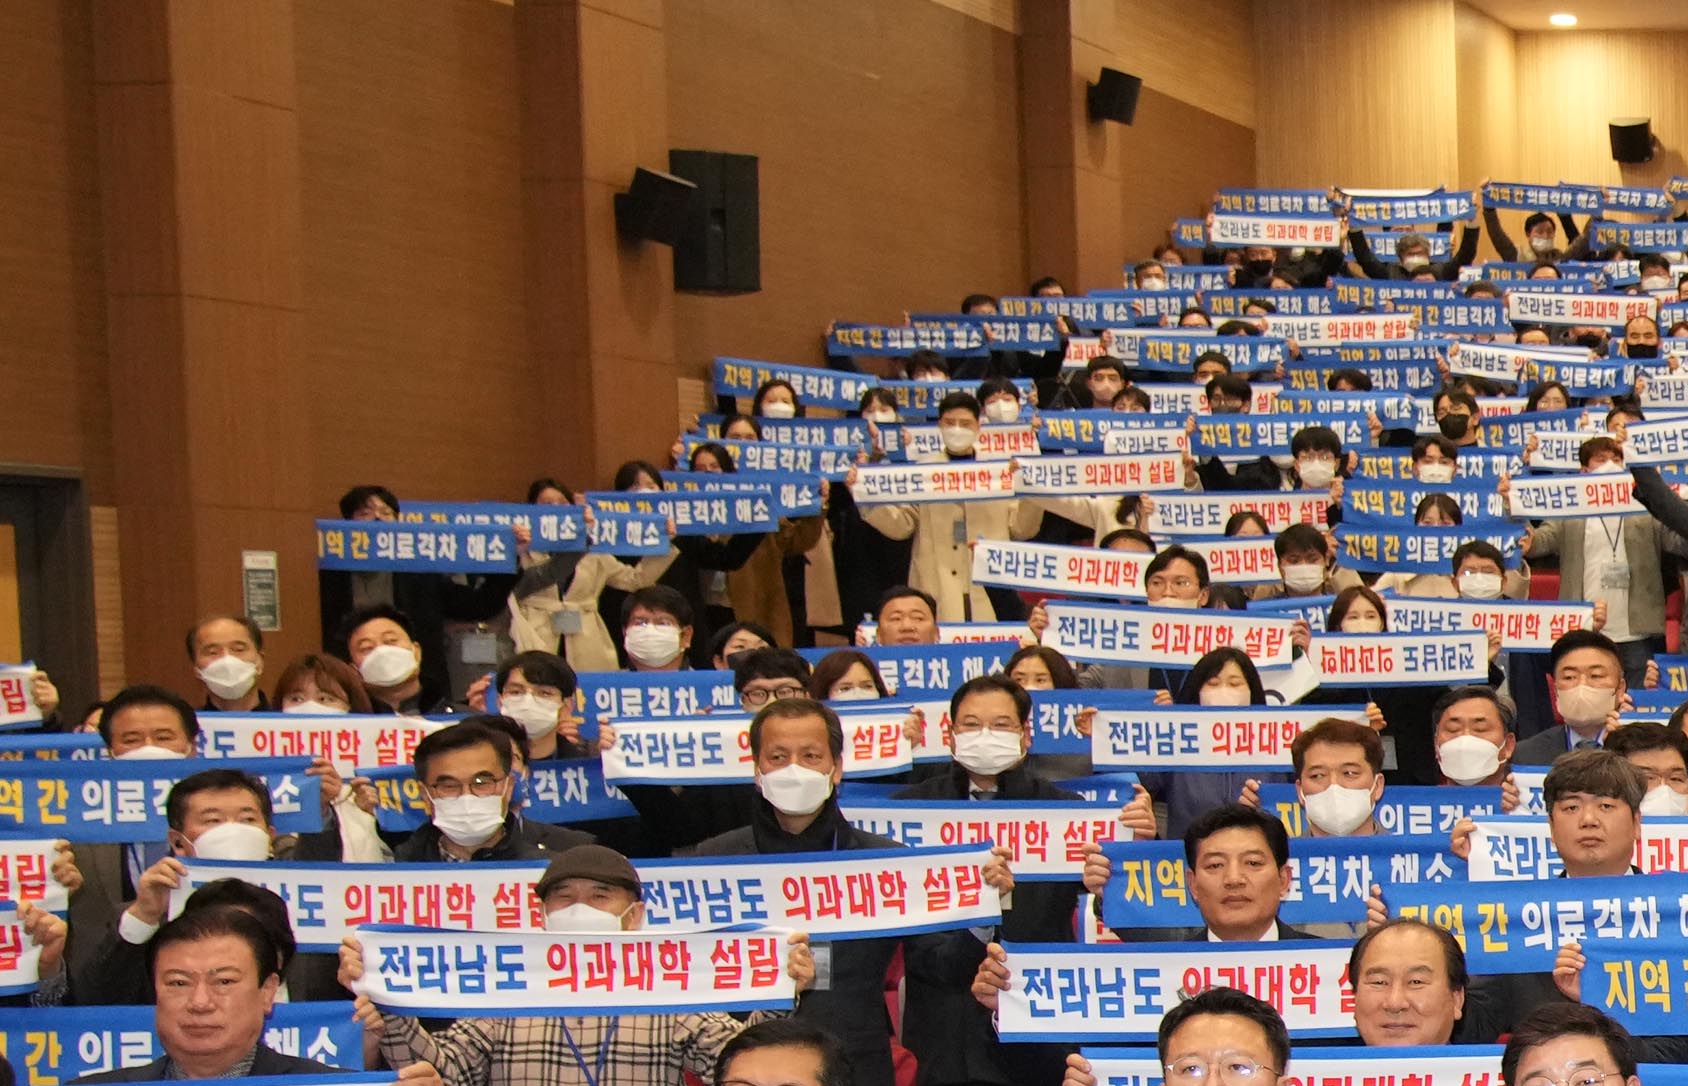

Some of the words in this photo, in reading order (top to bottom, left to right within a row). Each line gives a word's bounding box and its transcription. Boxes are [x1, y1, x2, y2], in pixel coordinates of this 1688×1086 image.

[1218, 221, 1261, 240] 전라남도
[1267, 224, 1308, 241] 의과대학
[1314, 224, 1333, 242] 설립
[1021, 465, 1076, 487] 전라남도
[1085, 463, 1141, 484] 의과대학
[1149, 460, 1175, 482] 설립
[540, 517, 575, 540] 해소
[852, 722, 901, 760] 설립
[39, 780, 68, 824] 간
[642, 878, 768, 925] 전라남도
[783, 870, 908, 921] 의과대학
[923, 866, 981, 911] 설립
[378, 945, 528, 994] 전라남도
[547, 939, 690, 993] 의과대학
[711, 938, 778, 988] 설립
[1605, 960, 1670, 1013] 지역
[1022, 968, 1164, 1018] 전라남도
[25, 1032, 62, 1086] 간
